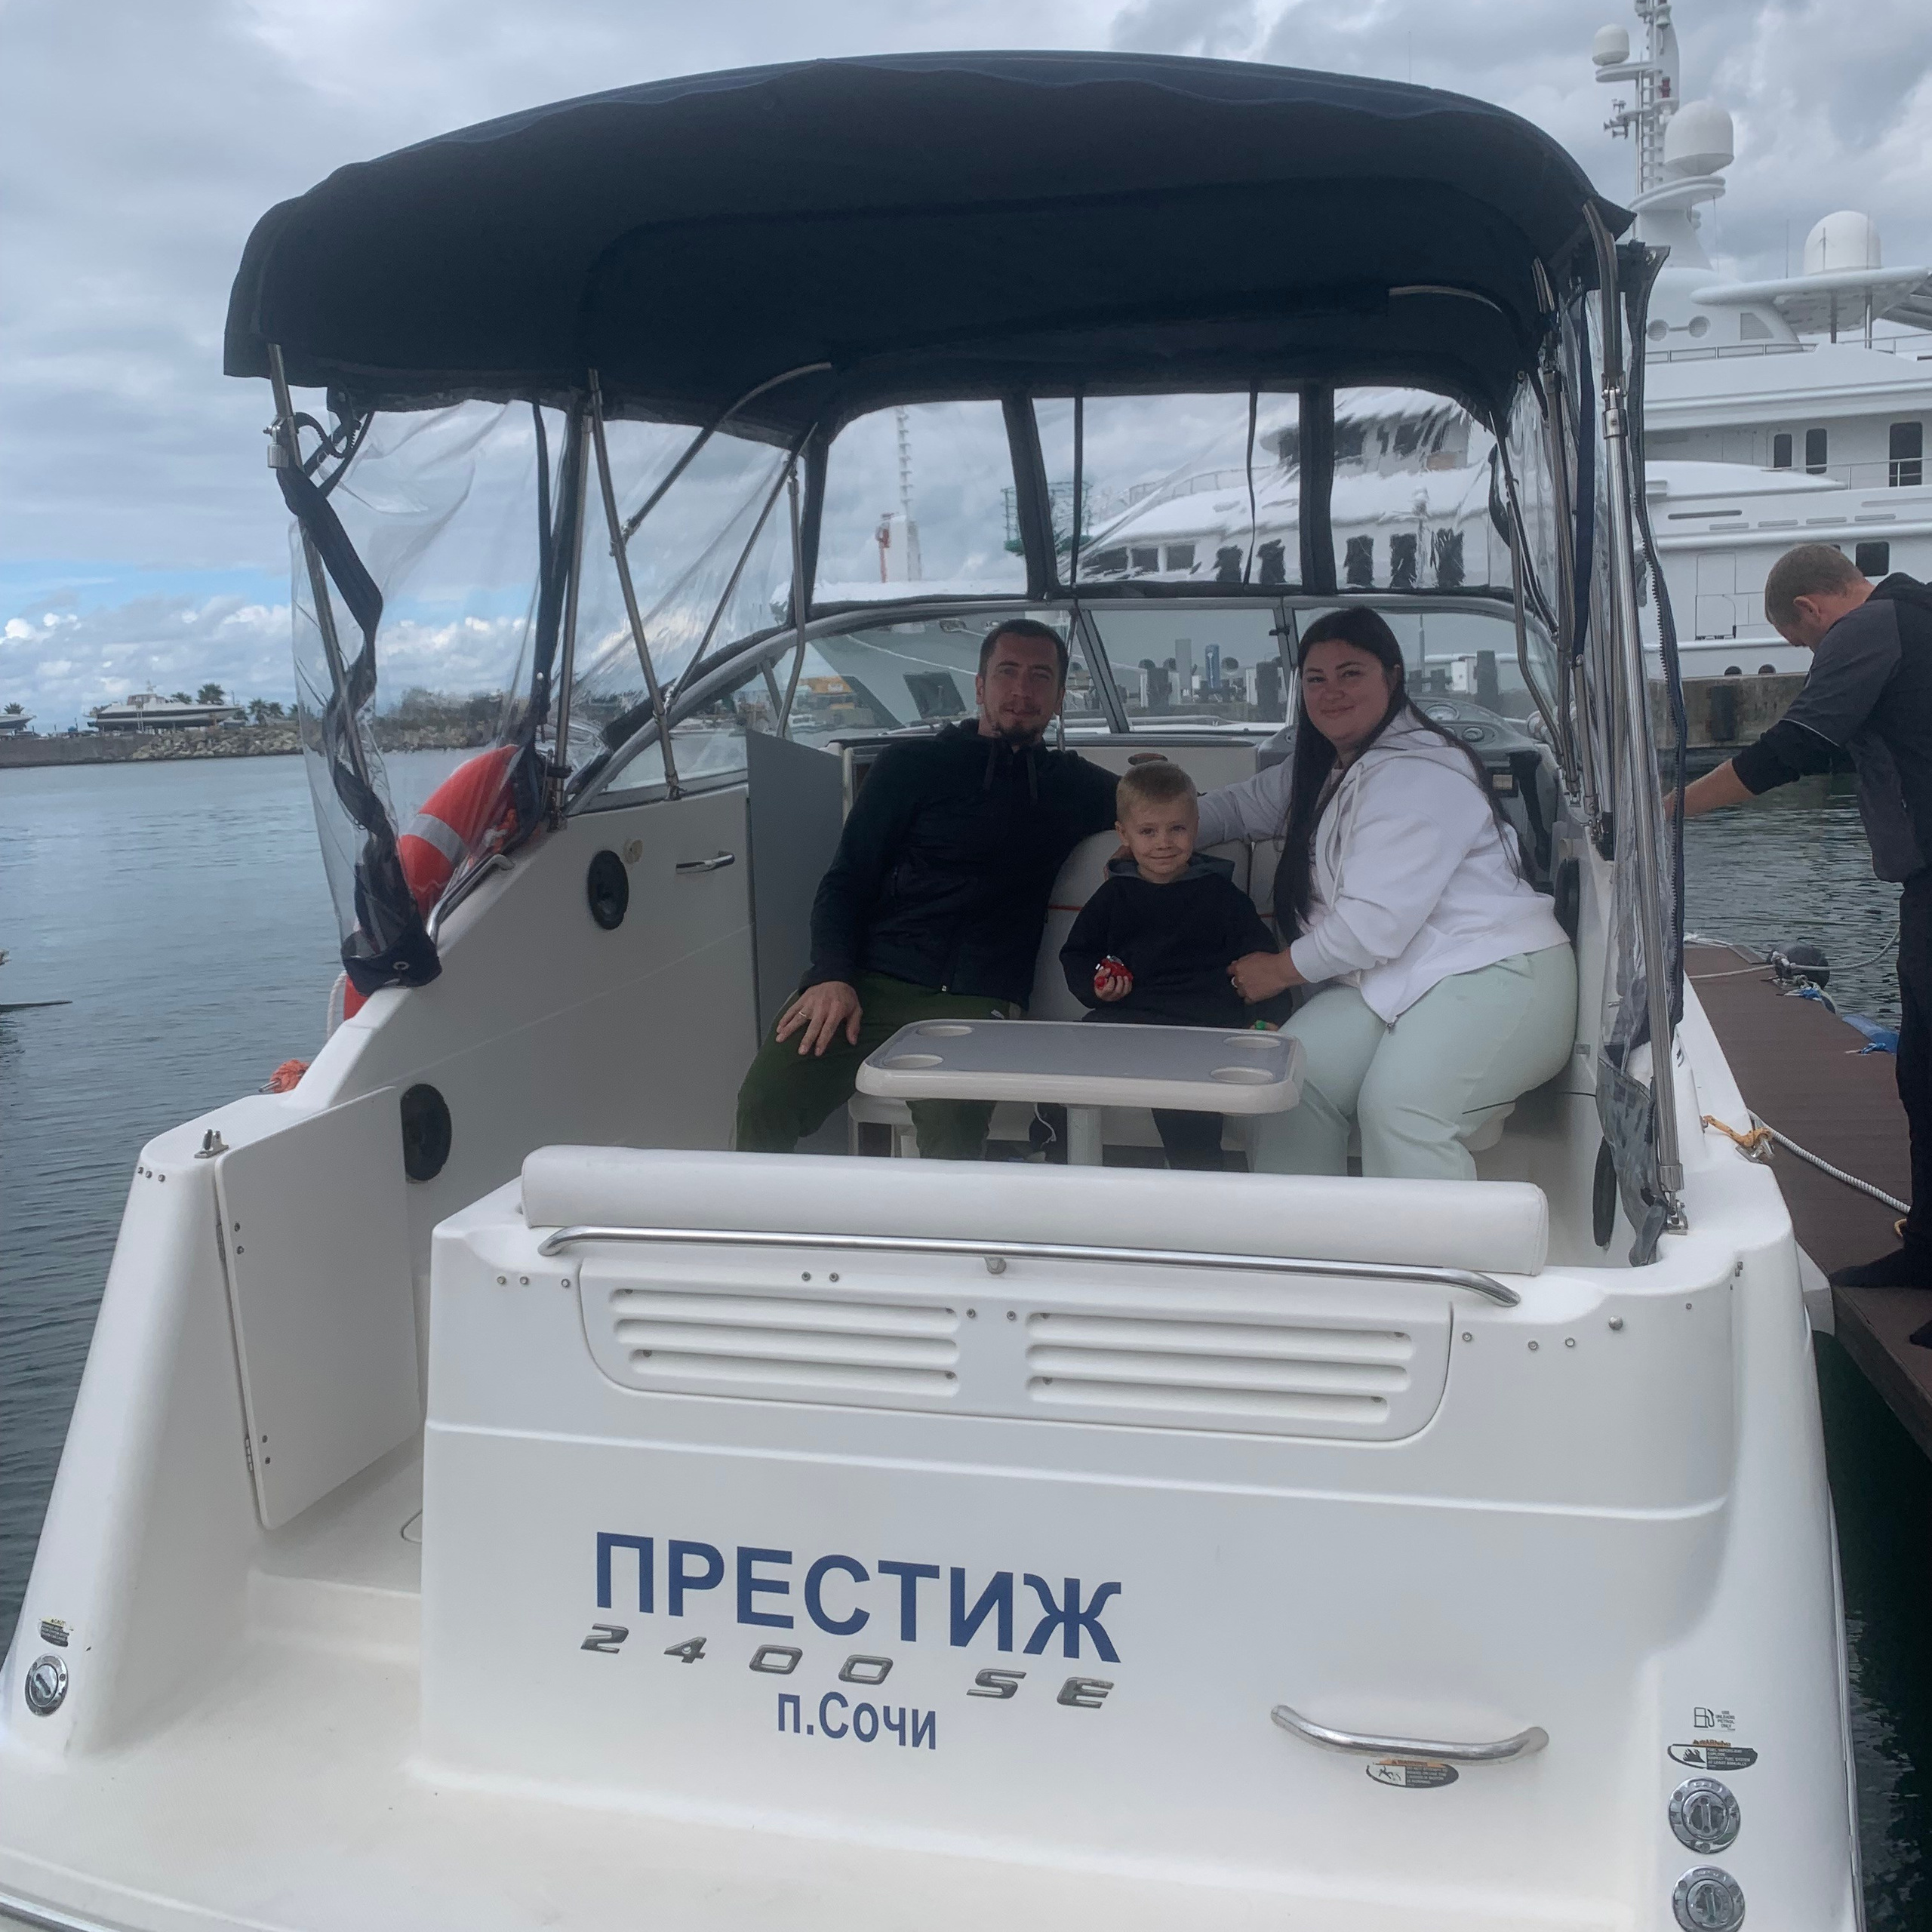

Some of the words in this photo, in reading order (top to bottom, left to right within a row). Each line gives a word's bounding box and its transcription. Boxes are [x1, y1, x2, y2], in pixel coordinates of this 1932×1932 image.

[596, 1531, 1122, 1664] ПРЕСТИЖ
[580, 1623, 894, 1686] 2400
[966, 1668, 1115, 1709] SE
[777, 1691, 936, 1750] п.Сочи
